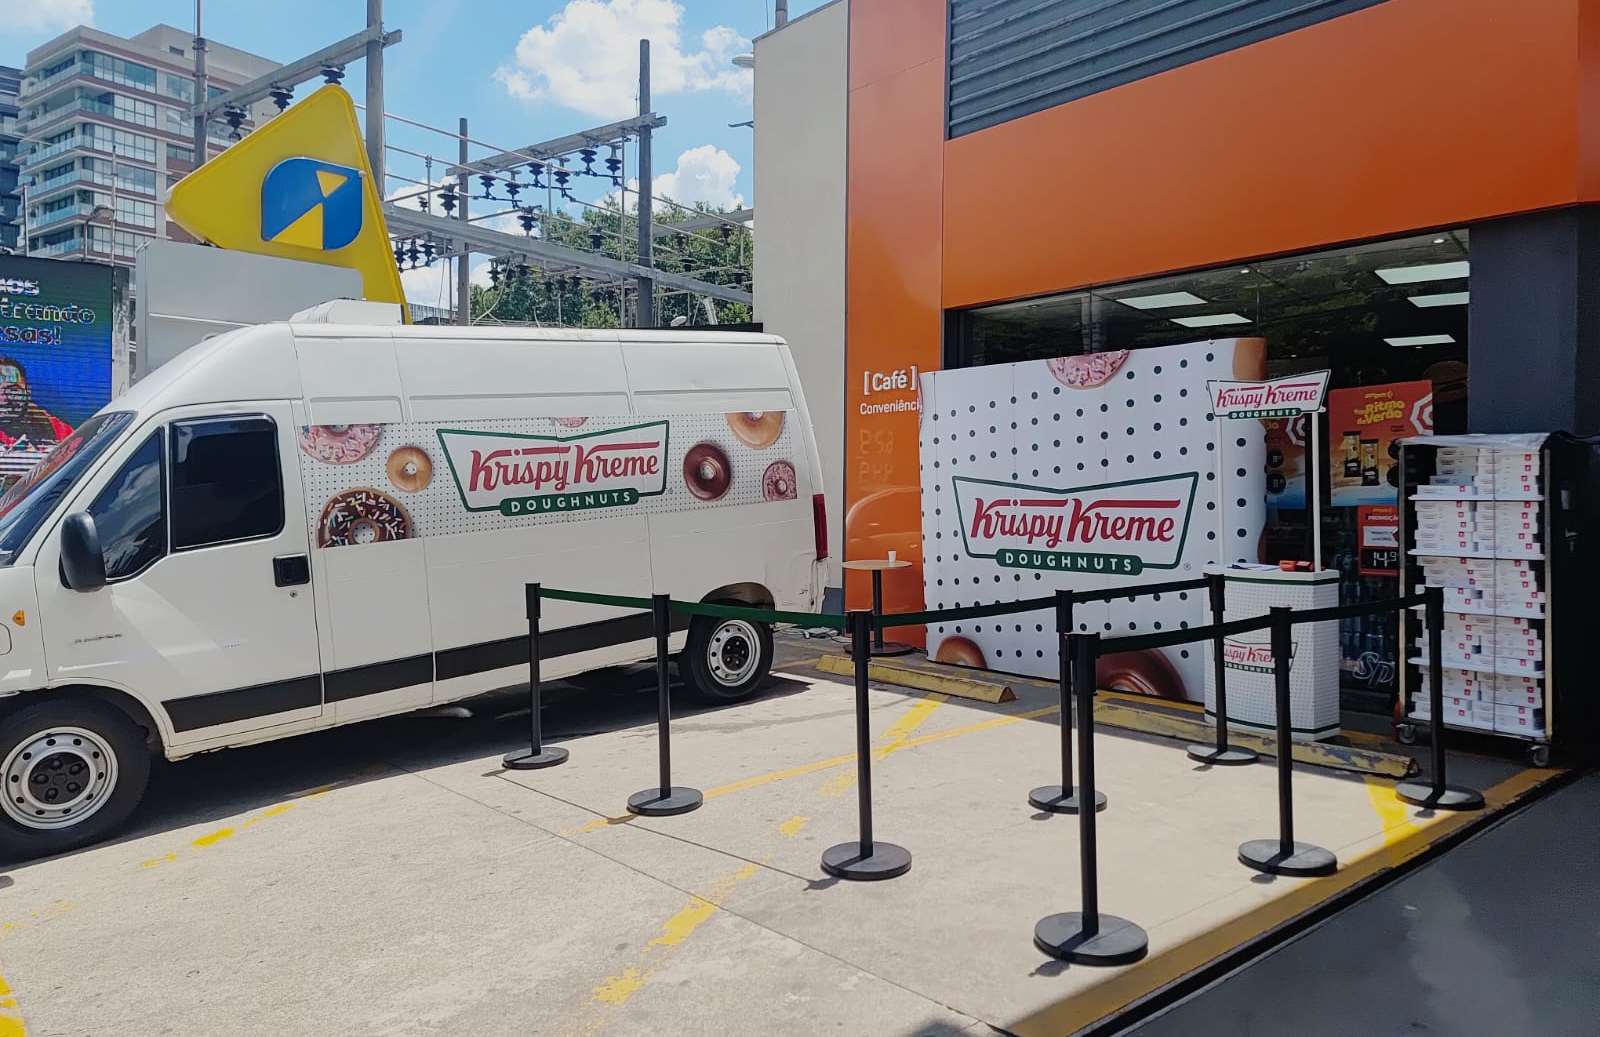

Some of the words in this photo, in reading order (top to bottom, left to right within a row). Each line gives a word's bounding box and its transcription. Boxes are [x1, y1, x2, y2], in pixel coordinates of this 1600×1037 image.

[0, 326, 62, 345] sas!
[1216, 386, 1265, 408] Krispy
[1265, 382, 1321, 404] Kreme
[859, 399, 921, 415] Conveniênci
[1231, 409, 1298, 418] DOUGHNUTS
[469, 446, 571, 491] Krispy
[574, 441, 660, 484] Kreme
[511, 491, 631, 513] DOUGHNUTS
[970, 498, 1068, 548] Krispy
[1067, 498, 1181, 543] Kreme
[1005, 552, 1132, 572] DOUGHNUTS
[1224, 643, 1247, 662] ispy
